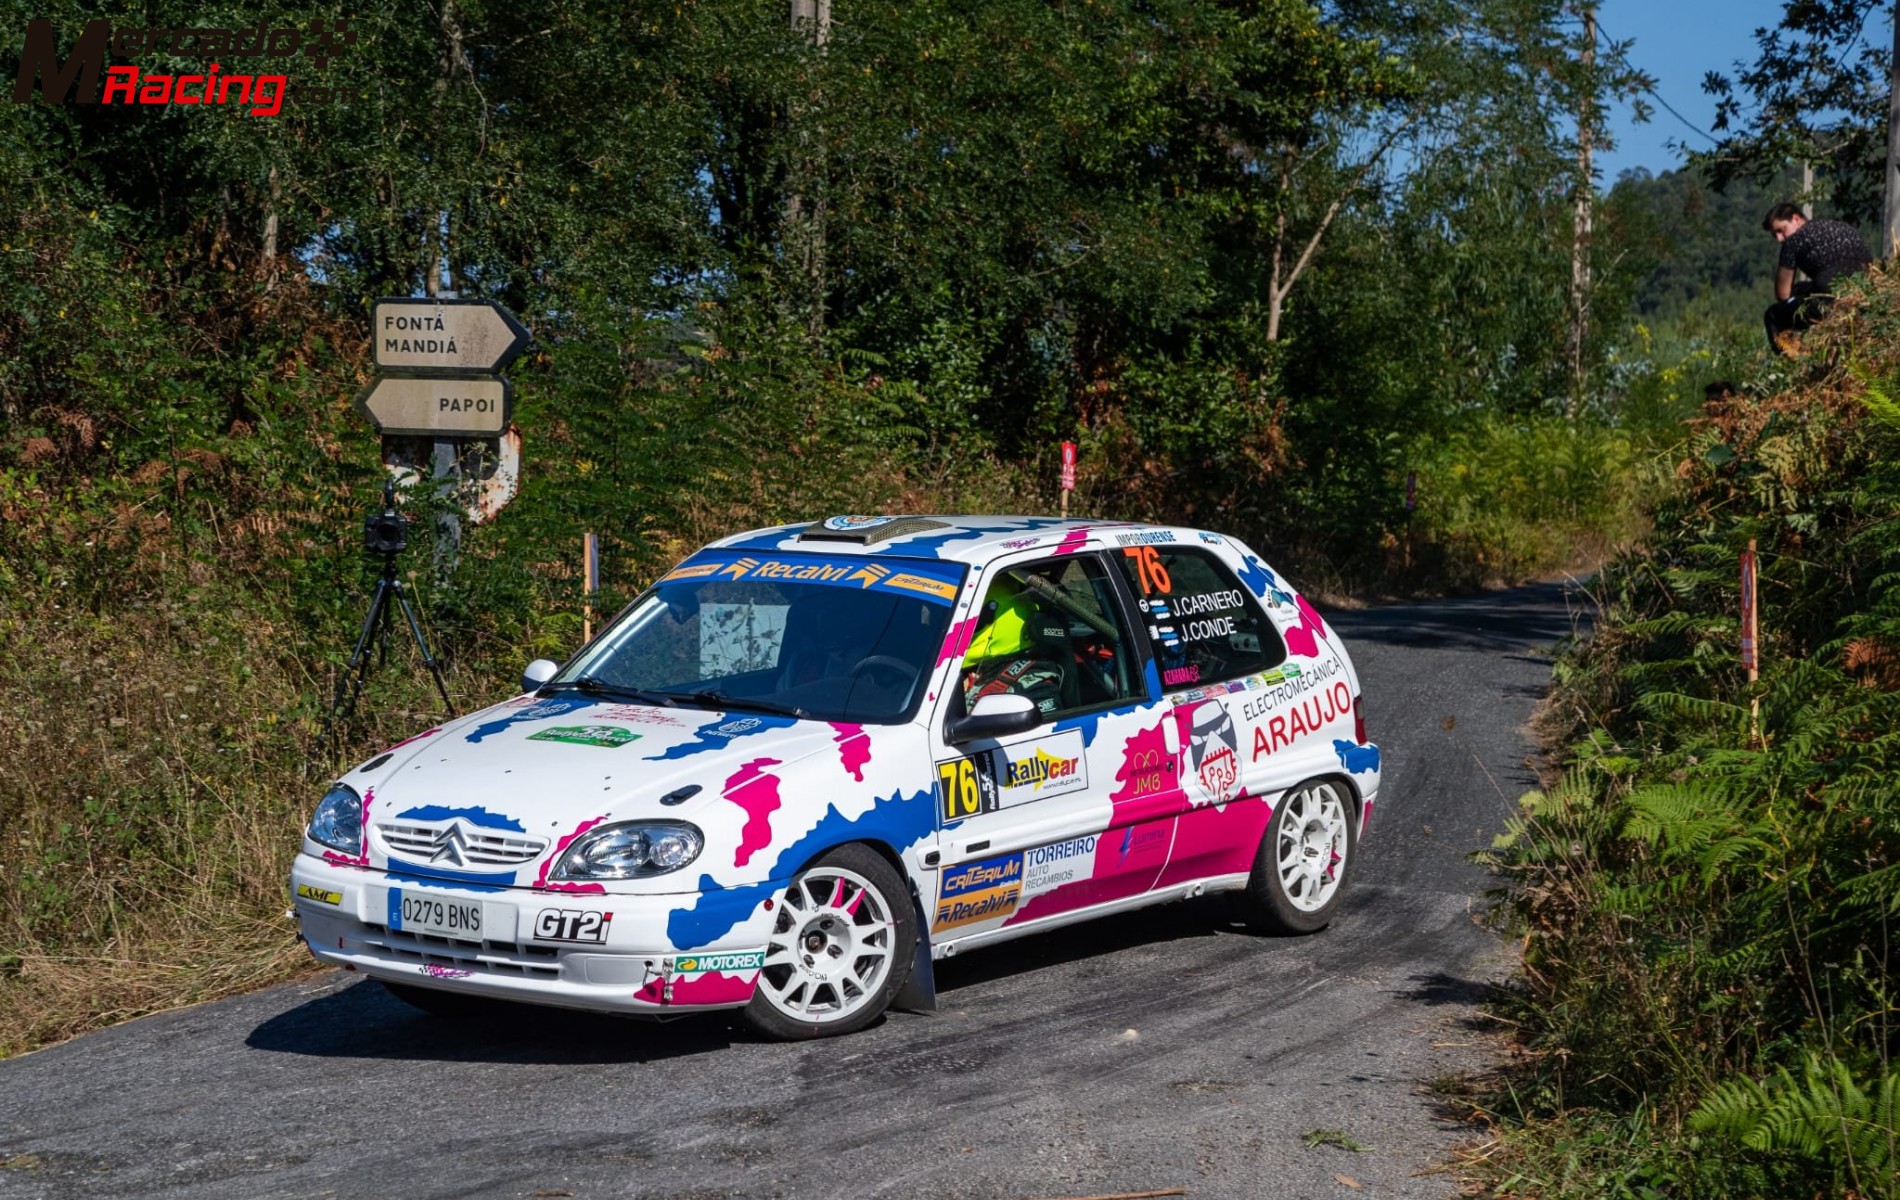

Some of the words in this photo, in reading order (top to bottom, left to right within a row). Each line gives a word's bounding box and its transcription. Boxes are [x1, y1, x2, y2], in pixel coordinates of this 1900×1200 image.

[384, 313, 445, 331] FONTÁ
[384, 337, 458, 354] MANDIÁ
[439, 398, 495, 413] PAPOI
[751, 561, 852, 581] Recalvi
[1123, 546, 1171, 594] 76
[1172, 589, 1245, 618] J.CARNERO
[1181, 616, 1238, 643] J.CONDE
[1243, 657, 1341, 722] ELECTROMECÁNICA
[1252, 681, 1351, 763] ARAUJO
[1007, 756, 1079, 784] Rallycar
[1133, 773, 1161, 795] JMB
[941, 758, 979, 817] 76
[1027, 837, 1095, 866] TORREIRO
[1025, 870, 1074, 891] RECAMBIOS
[1026, 865, 1049, 879] AUTO
[403, 898, 443, 926] 0279
[448, 904, 480, 931] BNS
[949, 891, 1007, 920] Recalvi
[534, 908, 614, 944] GT2i
[698, 954, 761, 971] MOTOREX
